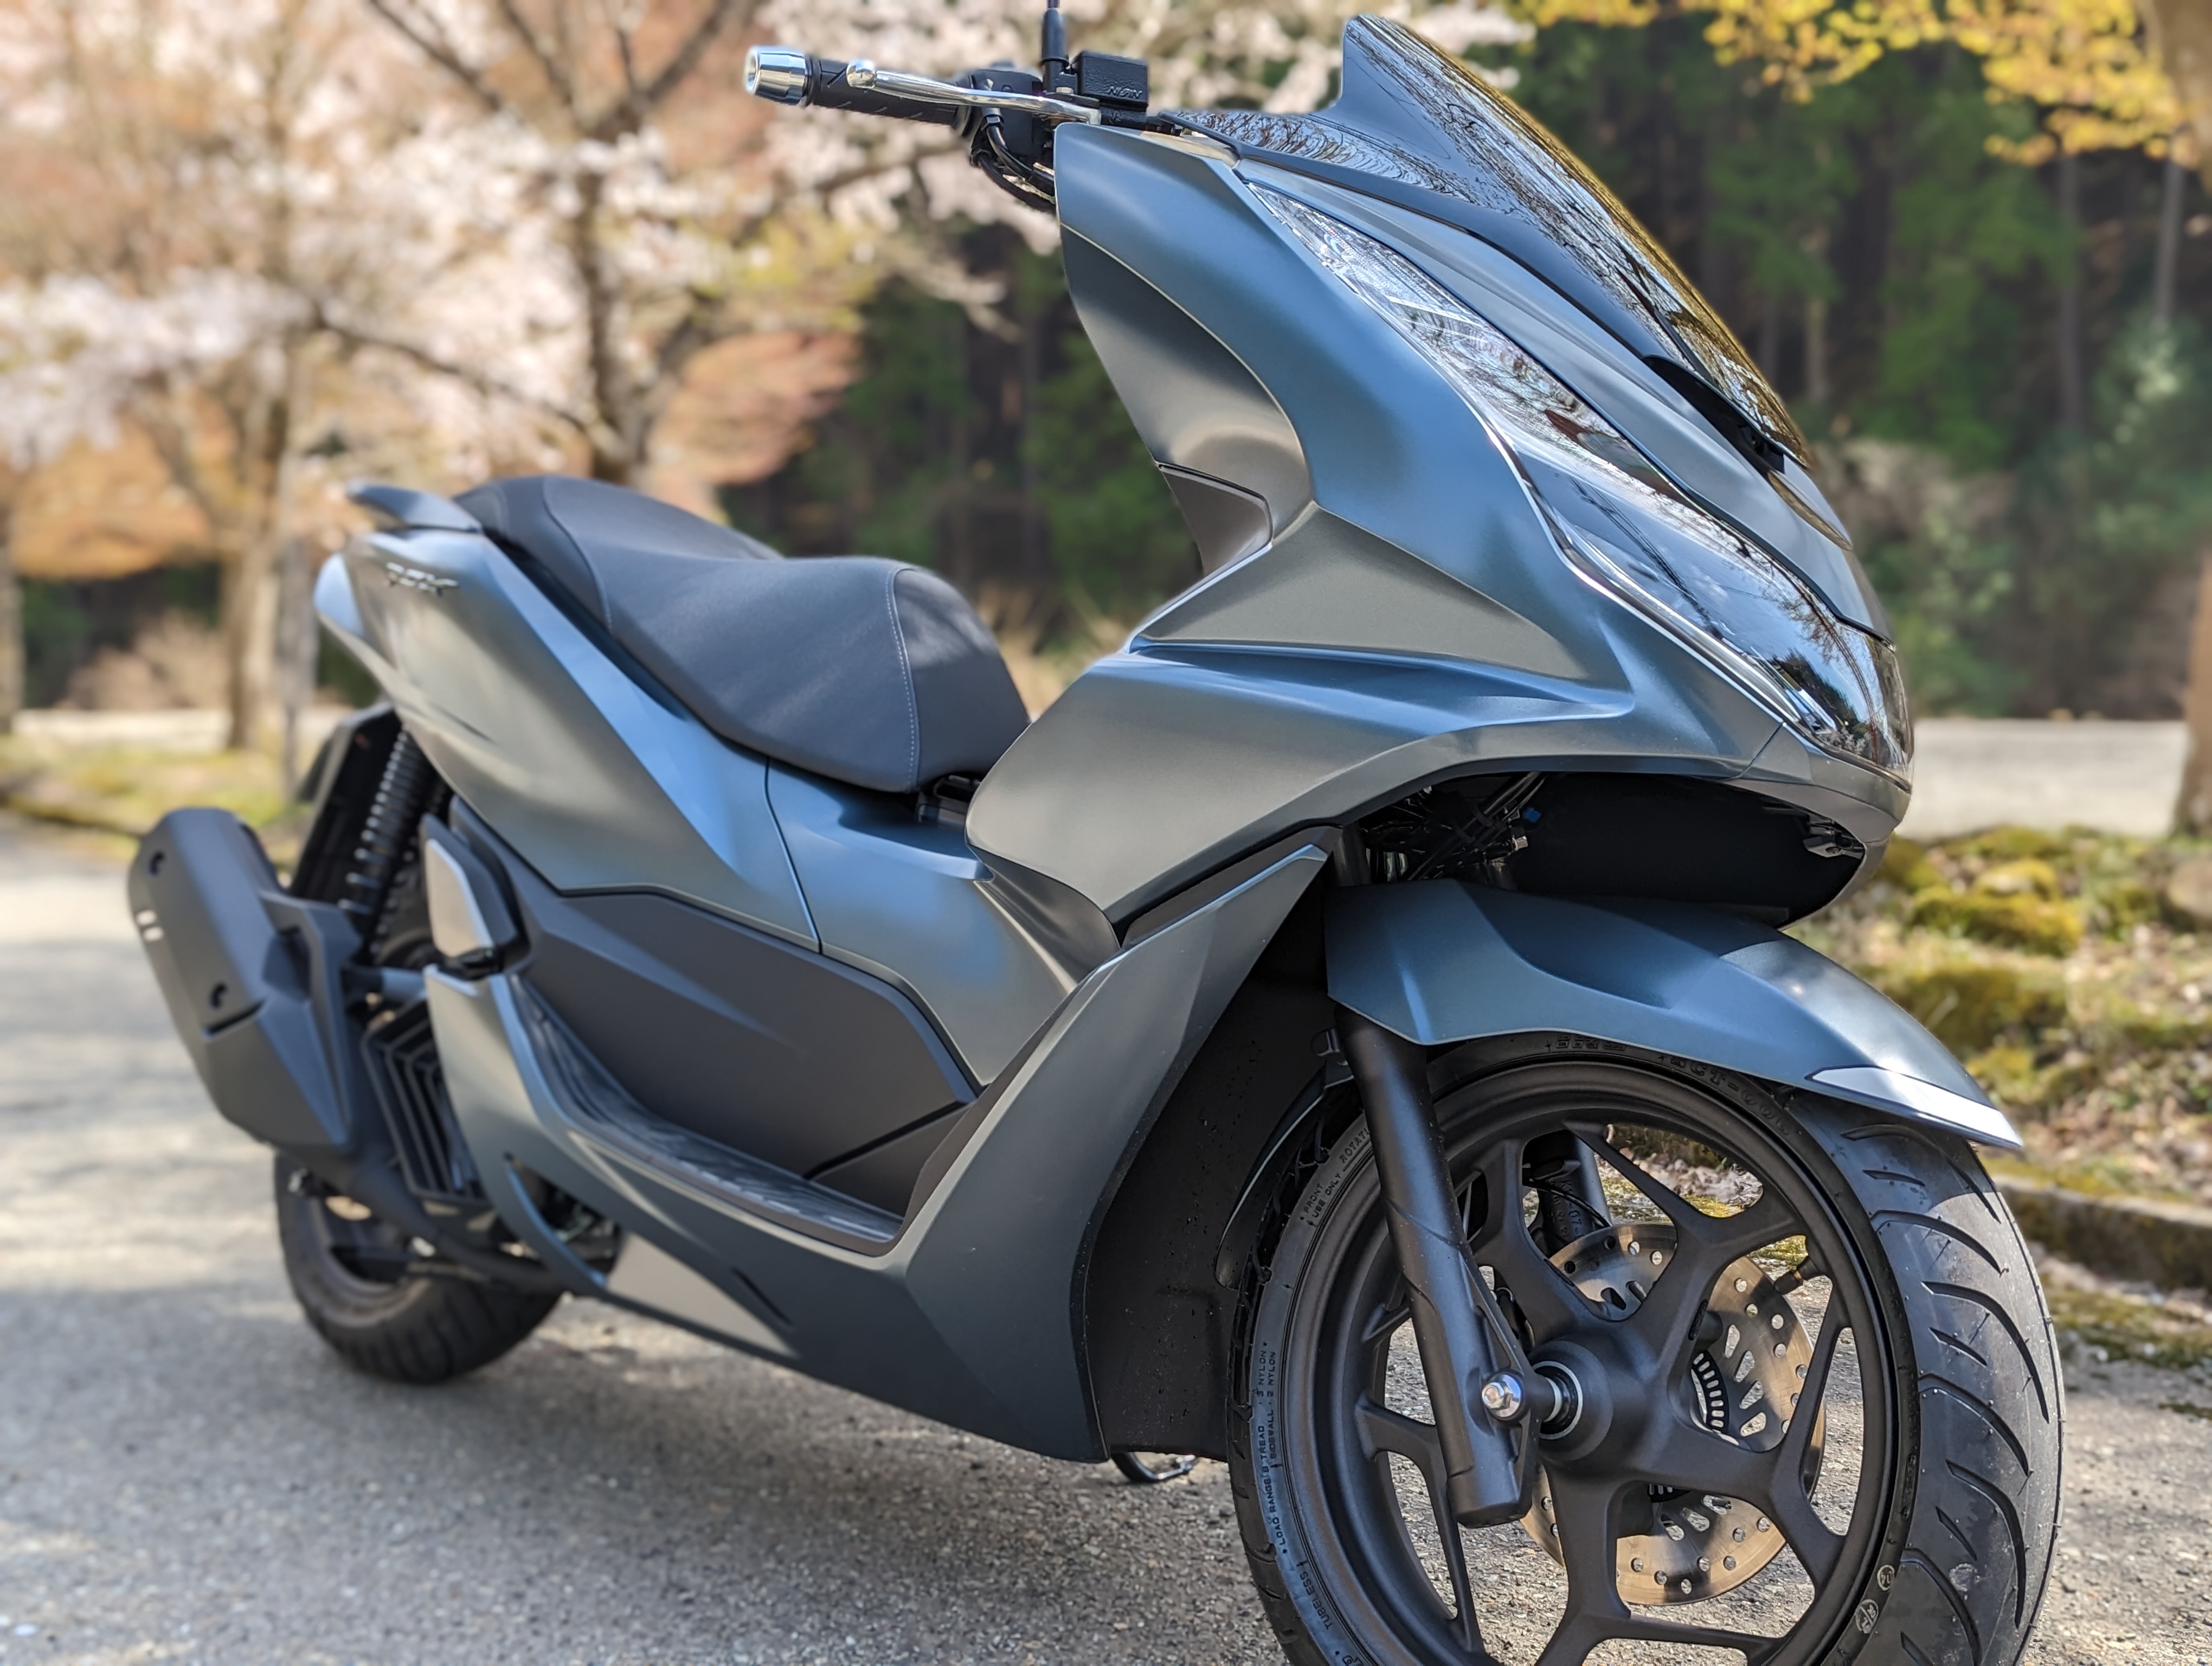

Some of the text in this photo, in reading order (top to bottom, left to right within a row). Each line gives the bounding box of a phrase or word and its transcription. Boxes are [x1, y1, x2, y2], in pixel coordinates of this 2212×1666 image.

[1303, 1183, 1323, 1213] FRONT
[1311, 1172, 1342, 1218] USE ONLY
[1258, 1350, 1266, 1385] NYLON
[1268, 1351, 1276, 1386] NYLON
[1258, 1425, 1267, 1460] TREAD
[1267, 1409, 1277, 1459] SIDEWALL
[1264, 1478, 1277, 1513] RANGE
[1272, 1517, 1286, 1546] LOAD
[1300, 1571, 1333, 1630] TUBELESS
